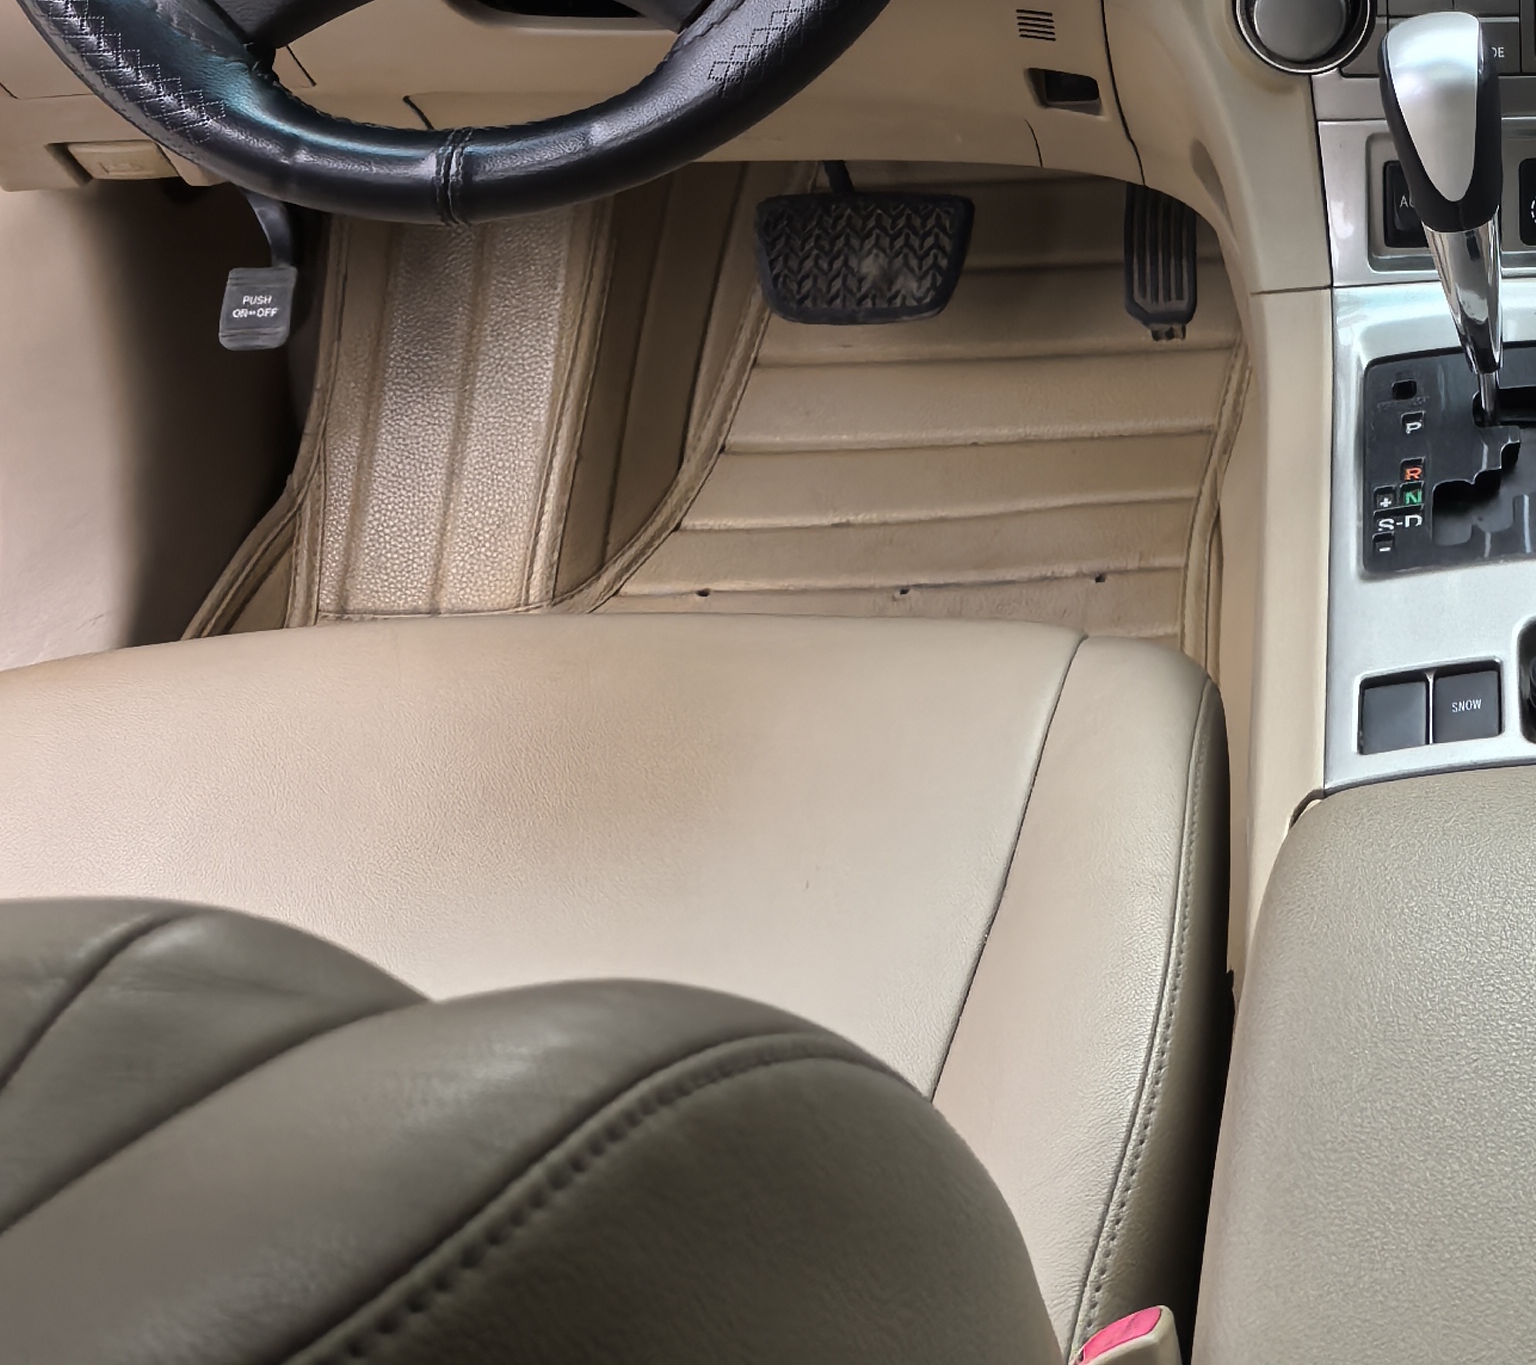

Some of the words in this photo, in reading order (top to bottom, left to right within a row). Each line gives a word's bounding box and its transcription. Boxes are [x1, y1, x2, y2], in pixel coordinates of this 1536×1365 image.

[242, 295, 273, 306] PUSH
[1405, 421, 1422, 435] P
[1404, 467, 1422, 481] R
[1404, 490, 1422, 505] N
[1451, 698, 1482, 713] SNOW
